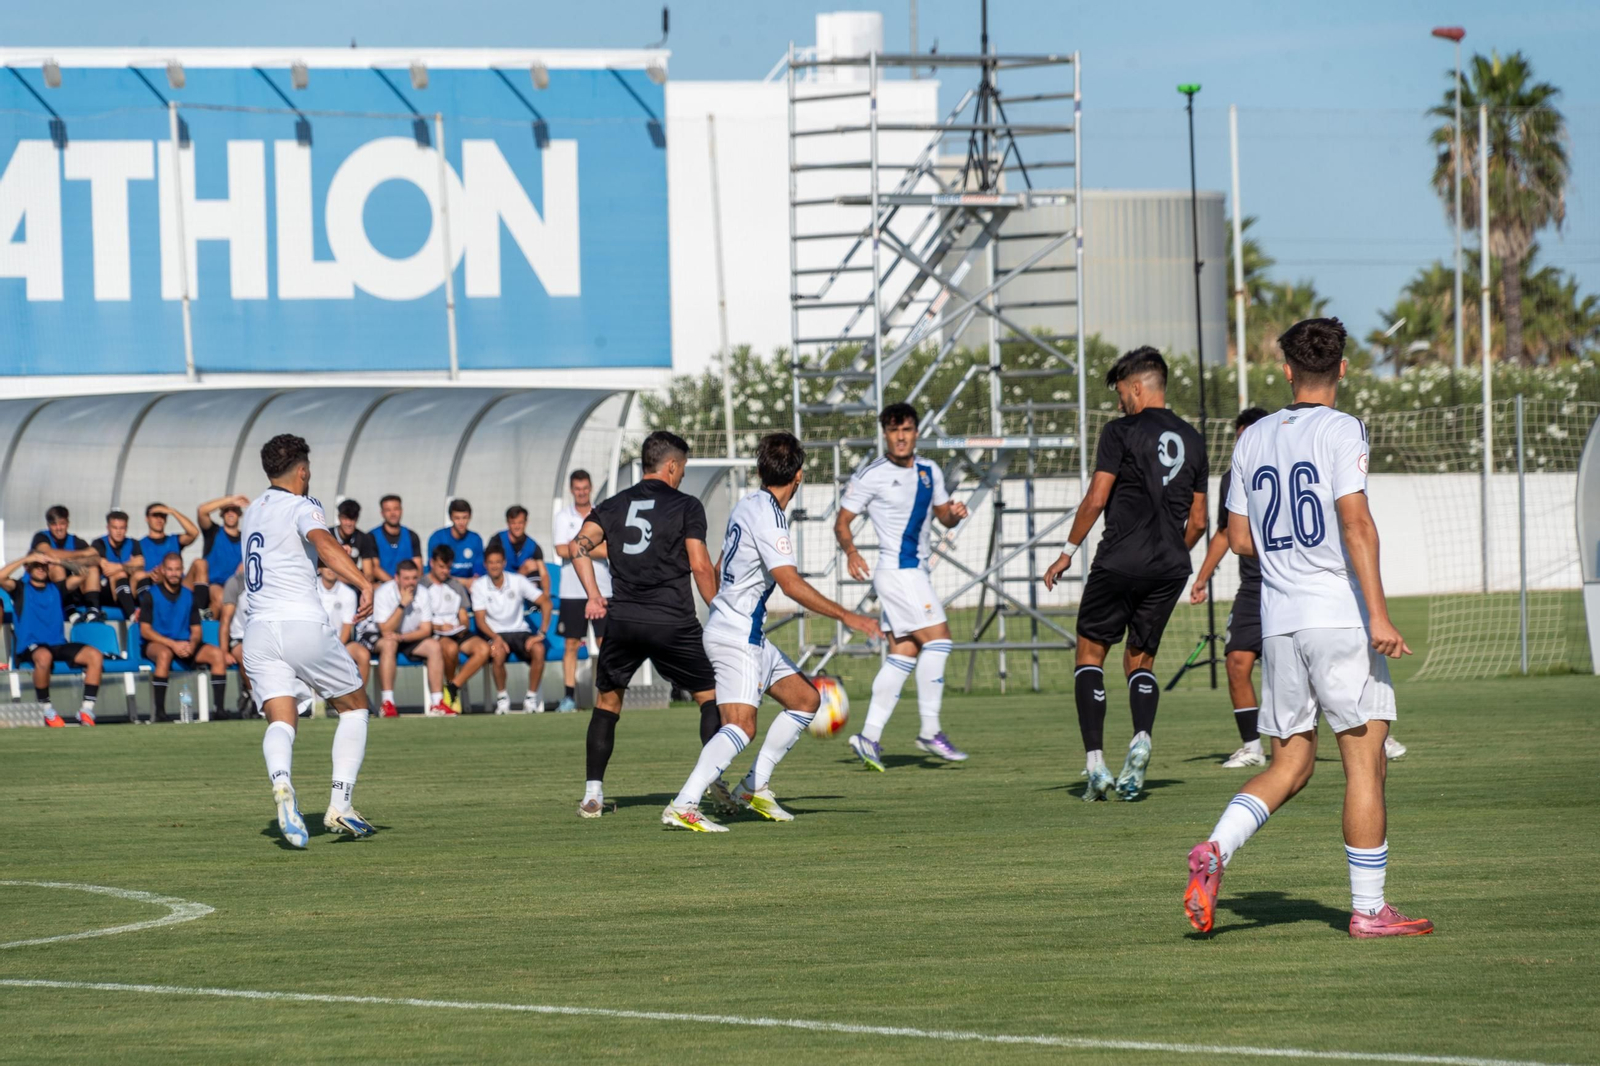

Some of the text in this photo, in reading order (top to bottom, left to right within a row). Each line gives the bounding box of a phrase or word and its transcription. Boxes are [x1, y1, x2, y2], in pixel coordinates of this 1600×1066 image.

[1157, 430, 1185, 486] 9
[623, 499, 655, 555] 5
[1252, 461, 1325, 552] 26
[245, 531, 264, 593] 6
